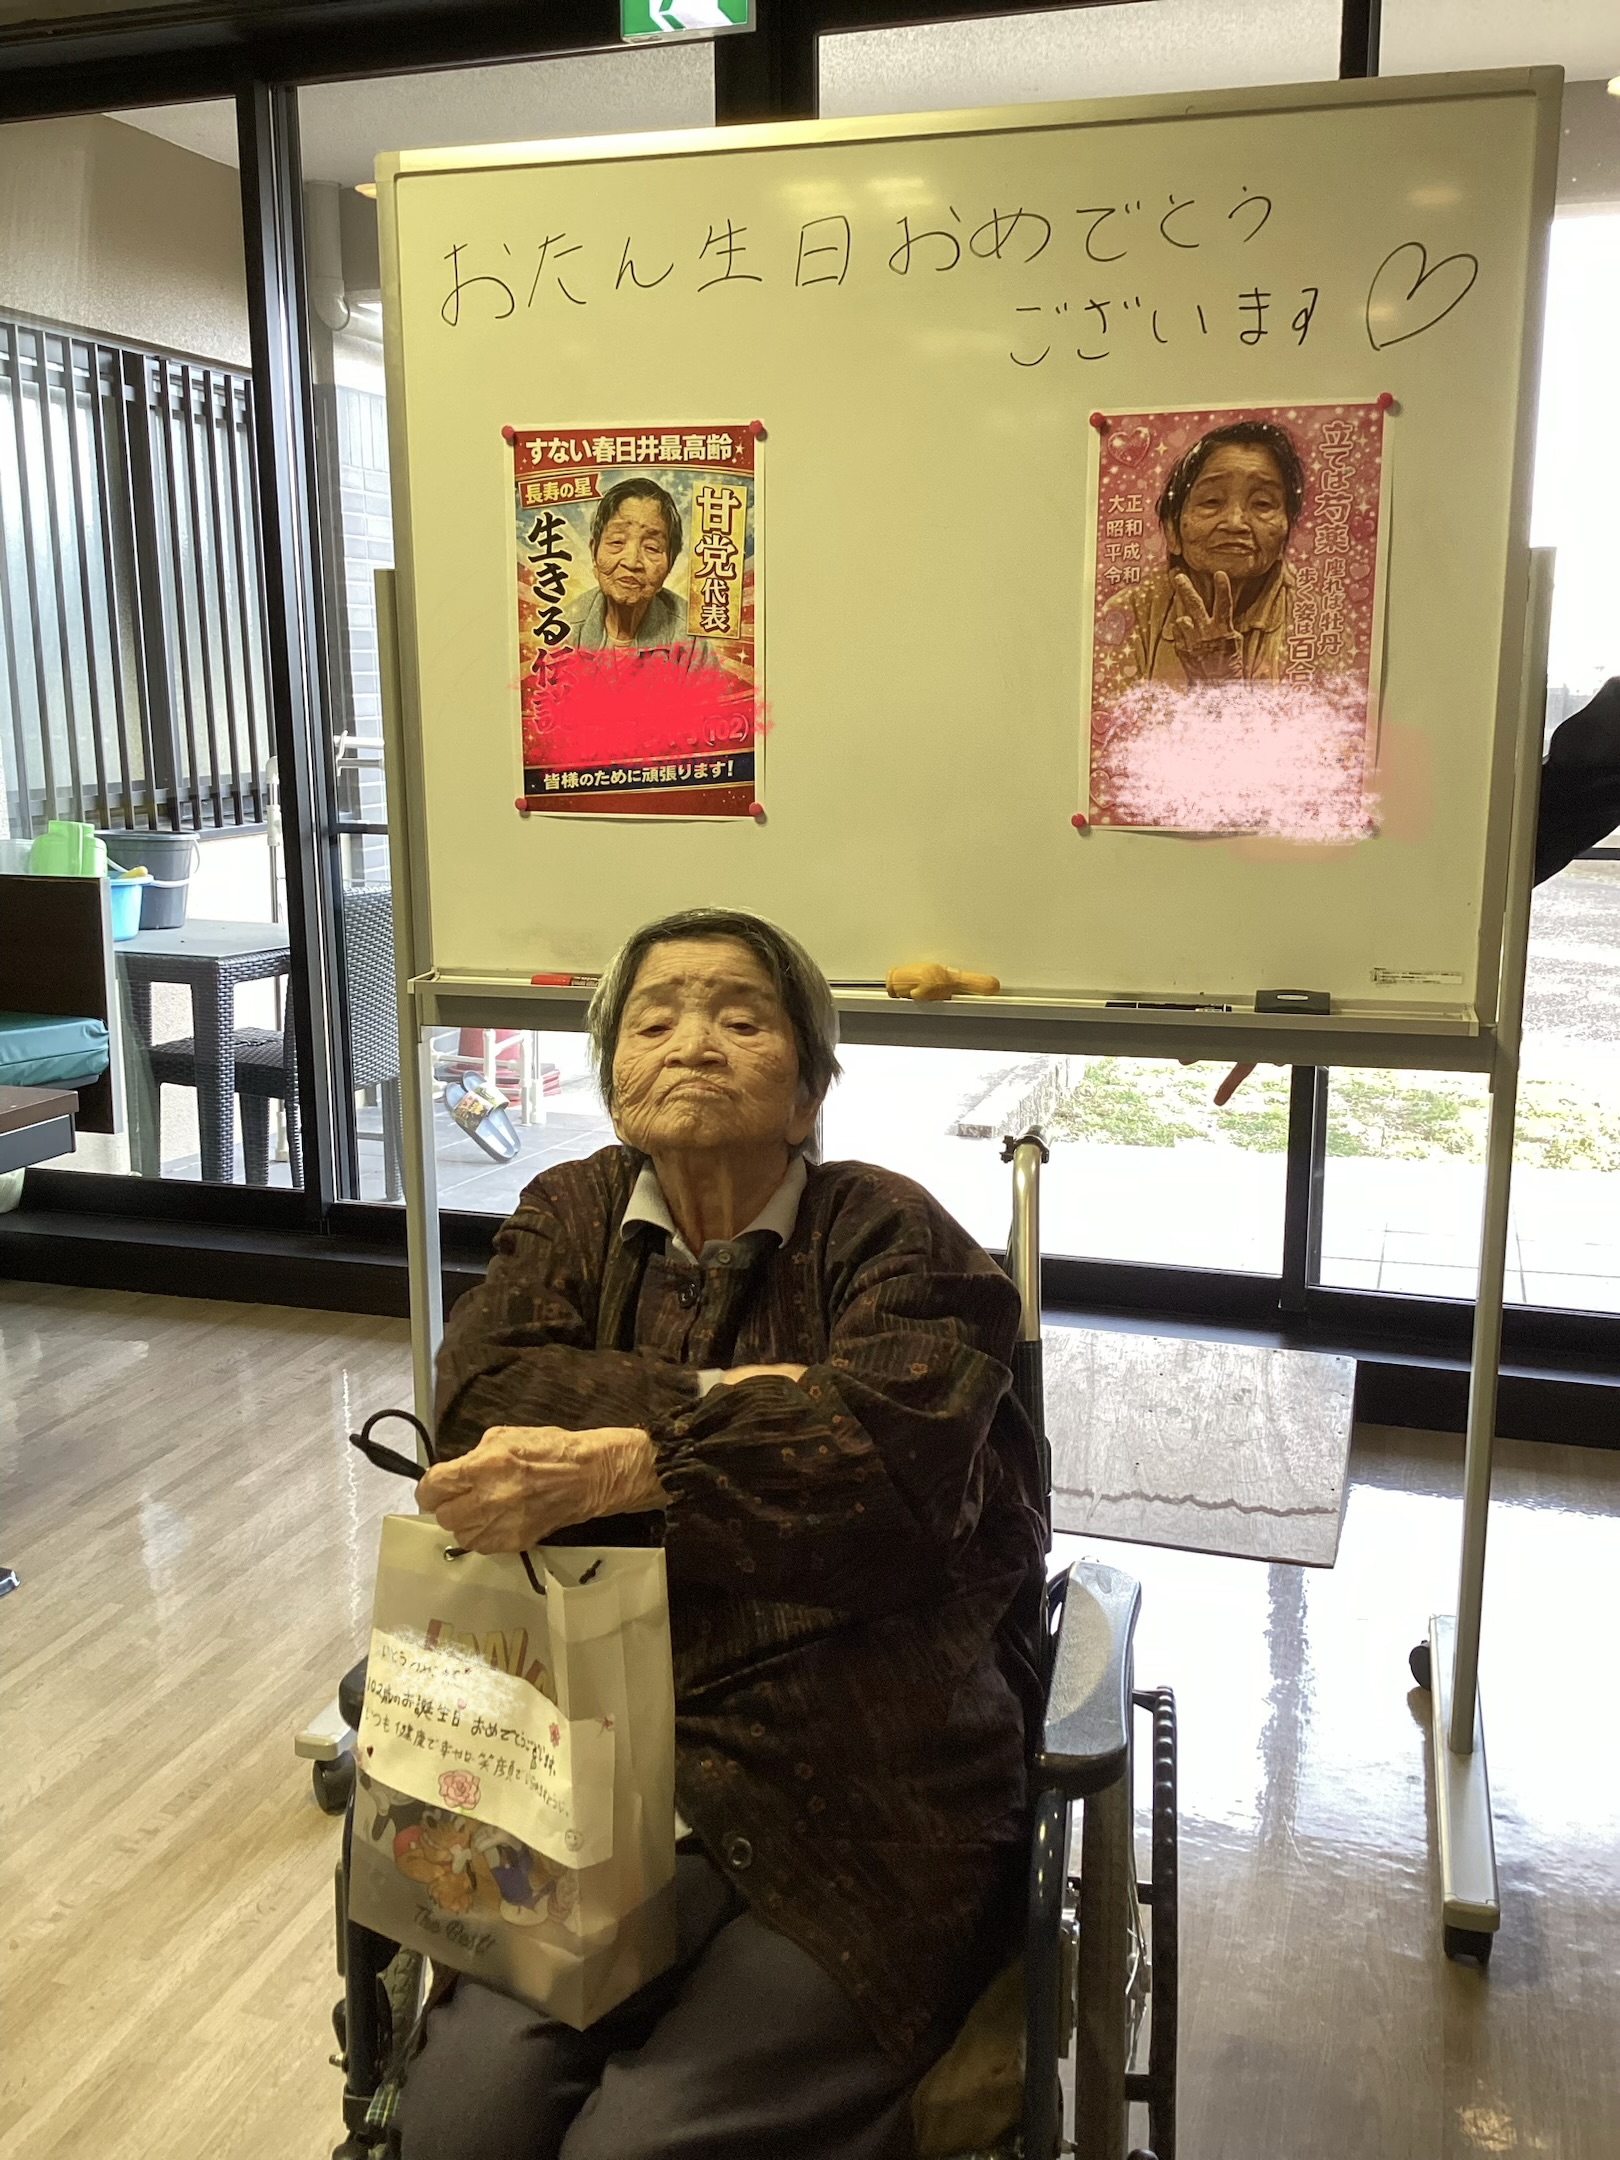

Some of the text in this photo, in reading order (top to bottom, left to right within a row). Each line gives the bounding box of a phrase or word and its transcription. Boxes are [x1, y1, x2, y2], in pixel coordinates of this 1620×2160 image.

[1010, 288, 1318, 366] ございます
[525, 433, 733, 465] すない春日井最高齢
[525, 477, 593, 504] 長寿の星
[1107, 494, 1143, 513] 大正
[1106, 519, 1143, 538] 昭和
[1314, 420, 1355, 655] 立てば芍薬 座れば牡丹
[695, 486, 742, 633] 甘党代表
[1104, 542, 1141, 561] 平成
[1103, 566, 1141, 585] 令和
